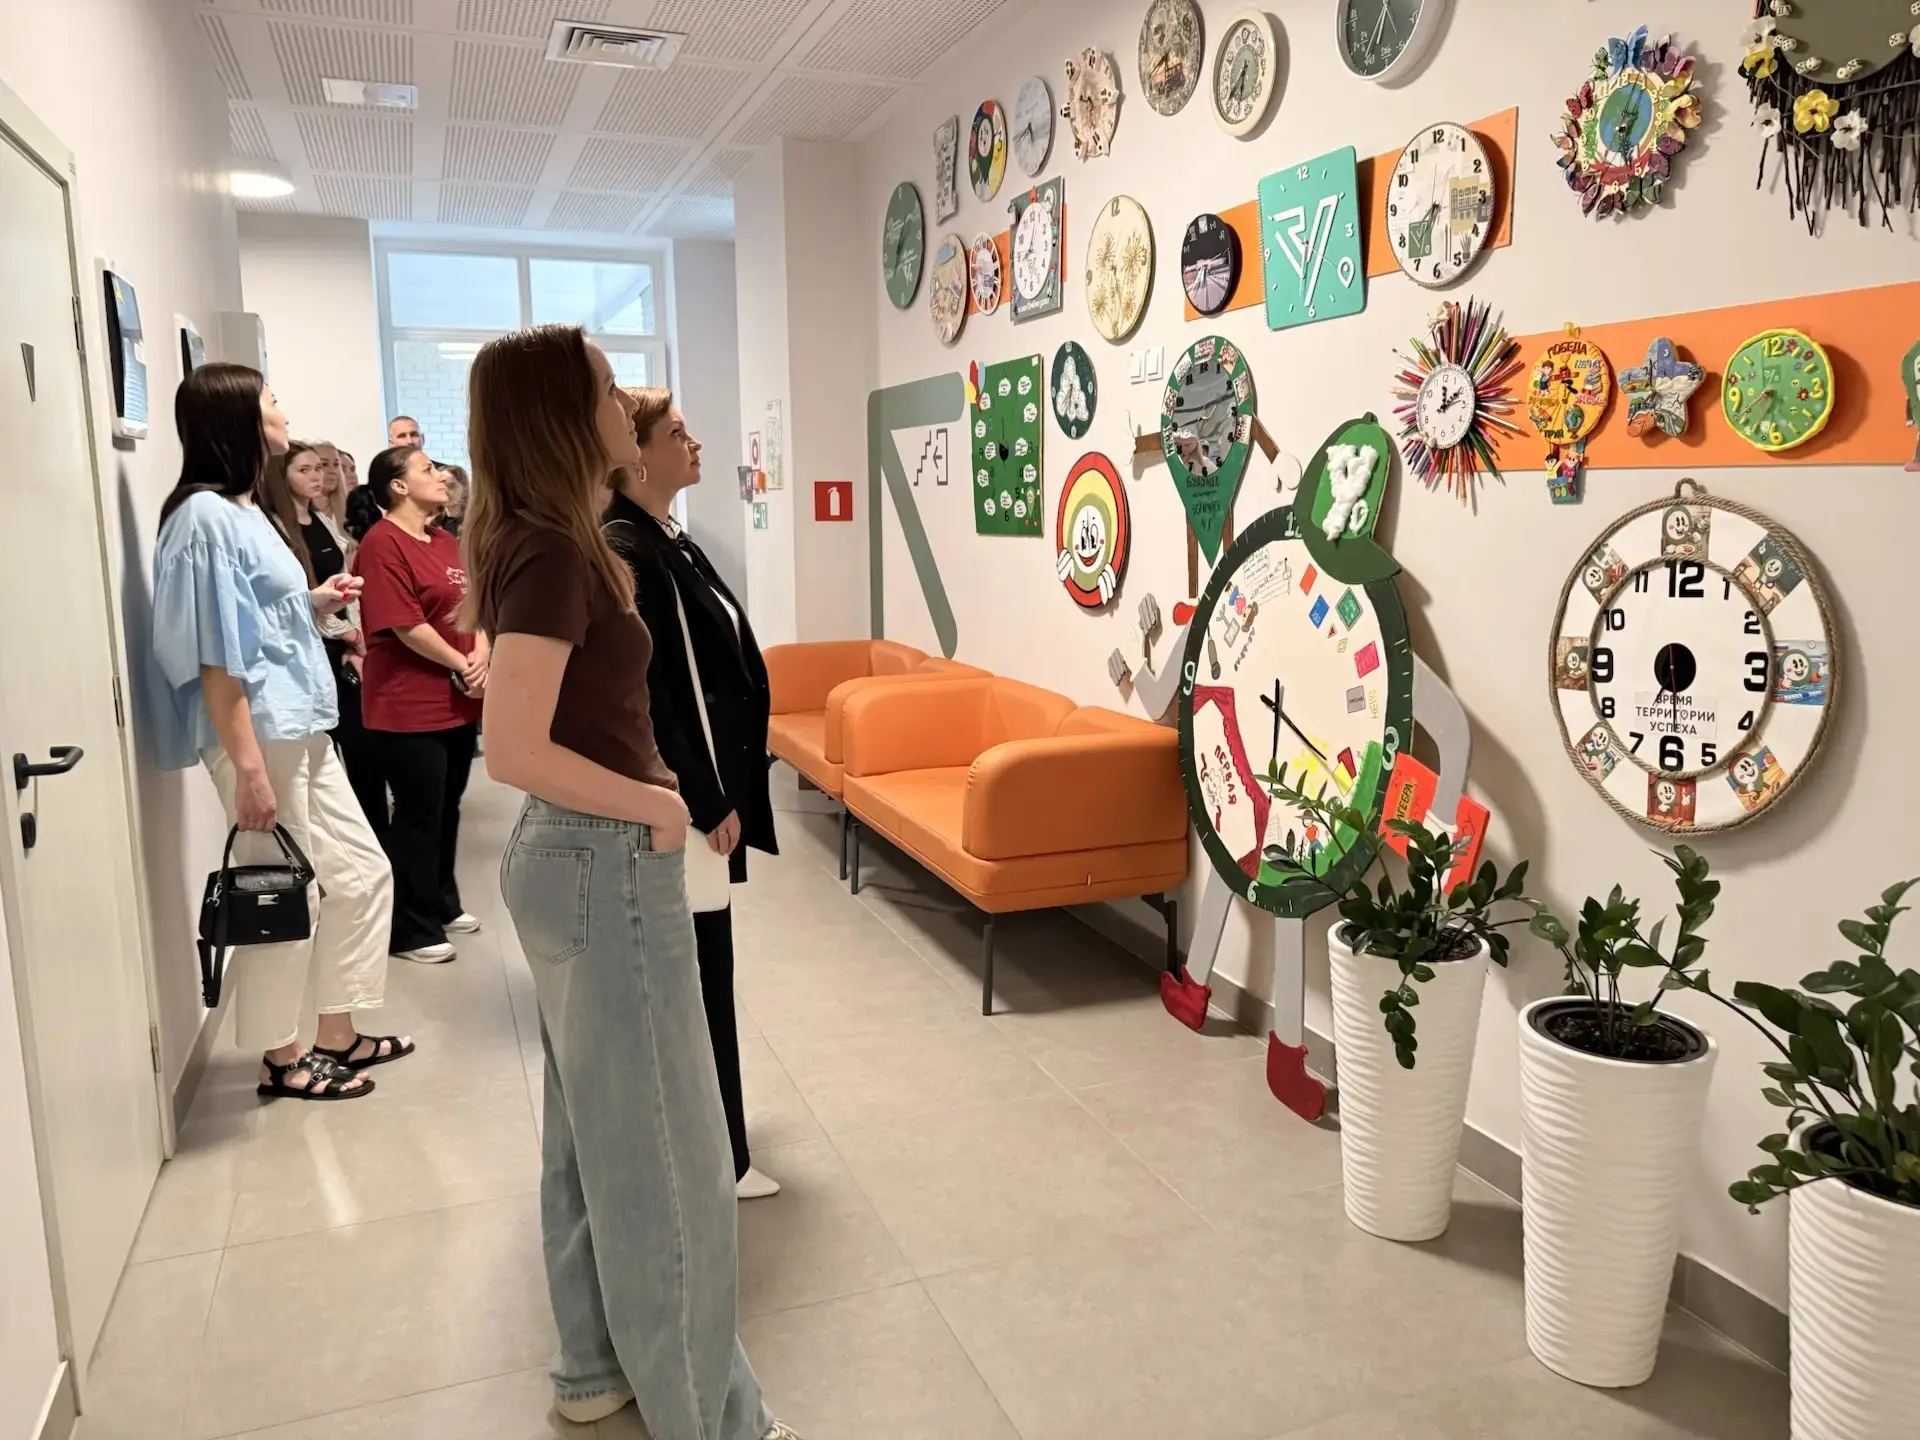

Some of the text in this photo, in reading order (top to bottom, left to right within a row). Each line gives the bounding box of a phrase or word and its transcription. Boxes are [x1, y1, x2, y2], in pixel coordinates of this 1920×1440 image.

[1432, 129, 1444, 144] 12
[1460, 138, 1466, 152] 1
[1410, 149, 1419, 164] 11
[1296, 166, 1309, 180] 12
[1473, 159, 1481, 173] 2
[1634, 161, 1643, 176] 5
[1399, 174, 1408, 188] 10
[1611, 180, 1619, 192] 6
[1478, 190, 1486, 203] 3
[1111, 196, 1120, 217] 12
[1390, 204, 1397, 216] 9
[1029, 210, 1035, 222] 12
[1042, 223, 1047, 235] 2
[1345, 223, 1353, 237] 3
[1472, 224, 1480, 237] 4
[1399, 234, 1406, 248] 8
[1264, 248, 1271, 261] 9
[1453, 252, 1461, 266] 5
[1414, 259, 1421, 272] 7
[1433, 262, 1441, 278] 6
[1086, 269, 1092, 286] 9
[1029, 281, 1034, 291] 6
[1308, 305, 1316, 318] 6
[1548, 341, 1587, 359] ПОБЕДА
[1762, 337, 1784, 357] 12
[1200, 362, 1208, 373] 12
[1443, 374, 1449, 383] 12
[1426, 389, 1433, 398] 10
[1810, 378, 1824, 399] 3
[1462, 401, 1466, 409] 3
[1729, 387, 1742, 411] 9
[1423, 404, 1426, 412] 9
[1425, 416, 1429, 424] 8
[1432, 427, 1436, 435] 7
[1451, 425, 1455, 433] 5
[1769, 422, 1784, 445] 6
[1188, 462, 1193, 471] 7
[1634, 570, 1649, 592] 11
[1665, 560, 1704, 597] 12
[1723, 576, 1730, 600] 1
[1603, 609, 1625, 631] 10
[1744, 610, 1760, 634] 2
[1592, 648, 1614, 683] 9
[1744, 652, 1769, 692] 3
[1183, 661, 1195, 696] 9
[1656, 694, 1693, 706] ВРЕМЯ
[1601, 697, 1615, 718] 8
[1635, 706, 1715, 722] ТЕРРИТОРИИ
[1650, 721, 1697, 735] УСПЕХА
[1738, 711, 1754, 731] 4
[1382, 726, 1400, 771] 3
[1629, 732, 1644, 754] 7
[1659, 735, 1684, 772] 6
[1701, 743, 1717, 766] 5
[1214, 745, 1237, 805] ПЕРВАЯ
[1247, 881, 1259, 903] 6
